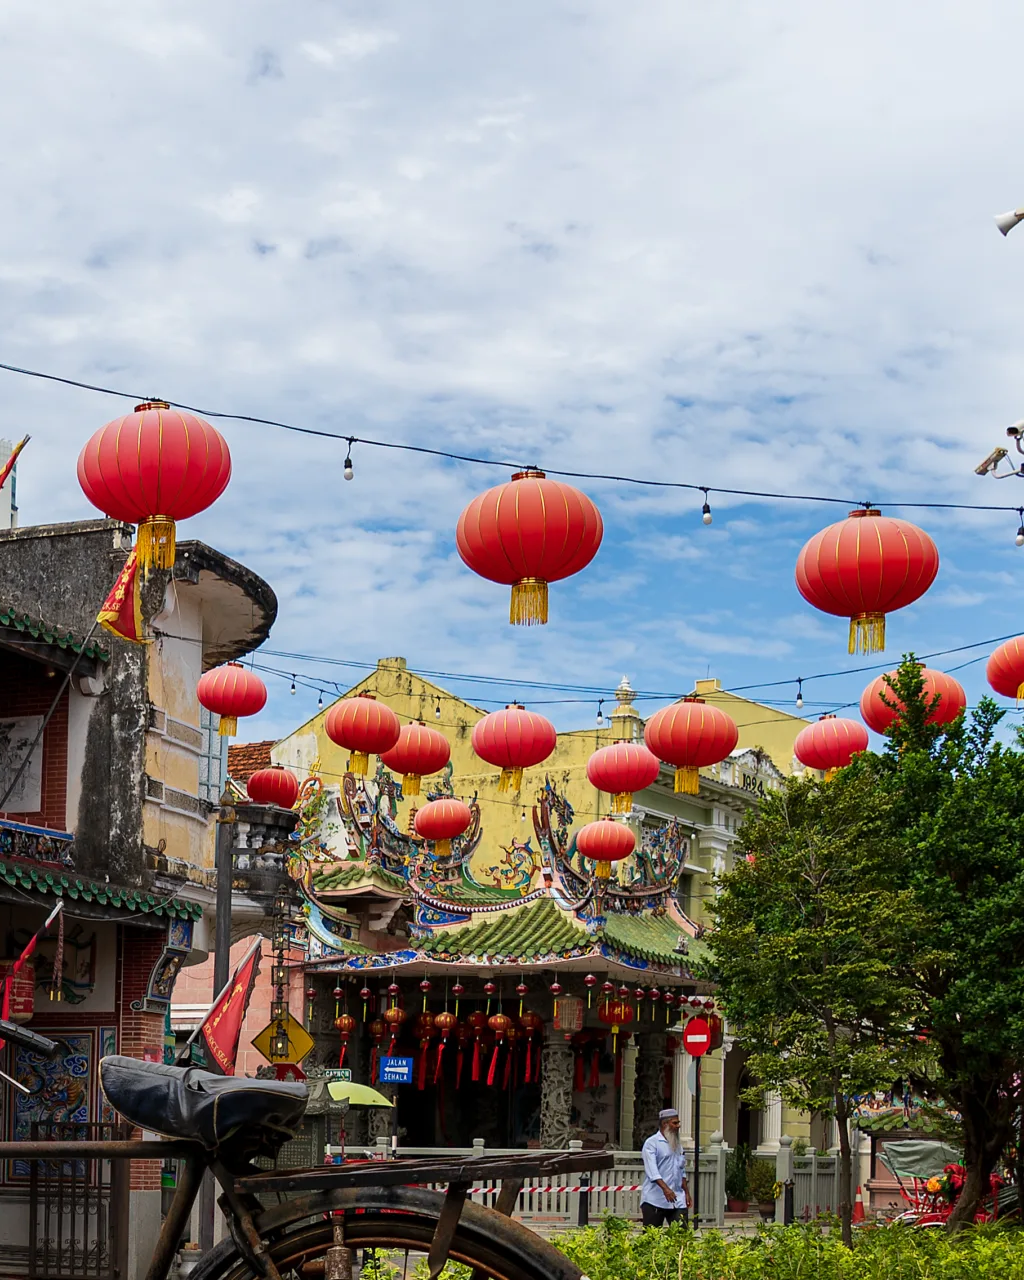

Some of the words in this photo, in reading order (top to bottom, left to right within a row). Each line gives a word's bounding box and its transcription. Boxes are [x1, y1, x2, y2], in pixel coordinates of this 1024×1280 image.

[743, 773, 766, 798] 1924
[386, 1059, 407, 1067] JALAN
[384, 1073, 408, 1081] SEHALA
